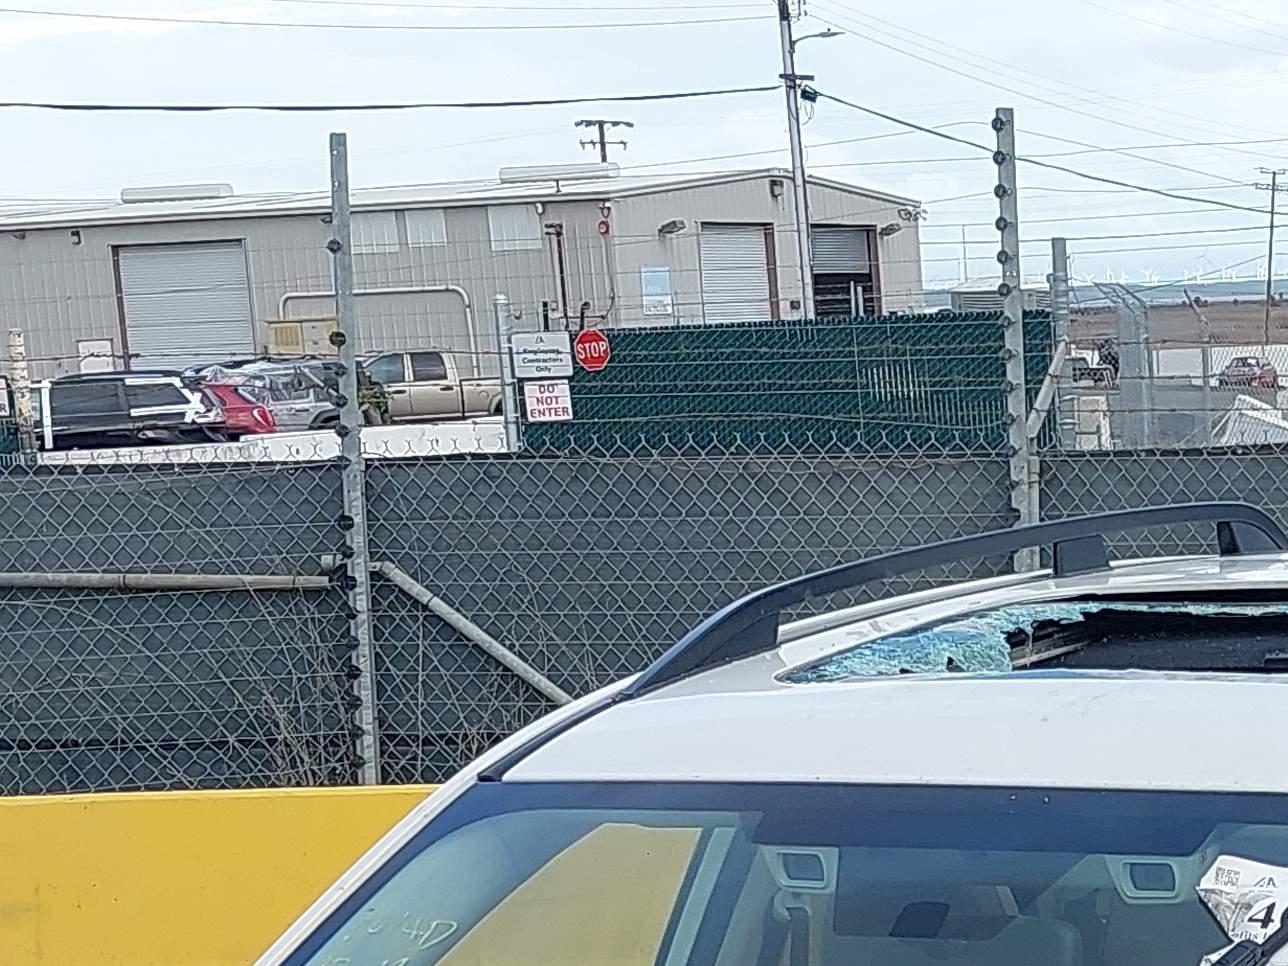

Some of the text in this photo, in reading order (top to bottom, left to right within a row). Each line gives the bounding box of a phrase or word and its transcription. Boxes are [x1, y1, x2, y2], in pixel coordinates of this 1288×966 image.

[577, 341, 607, 360] STOP
[535, 366, 552, 374] Only
[538, 384, 556, 395] DO
[536, 396, 560, 406] NOT
[530, 407, 570, 419] ENTER
